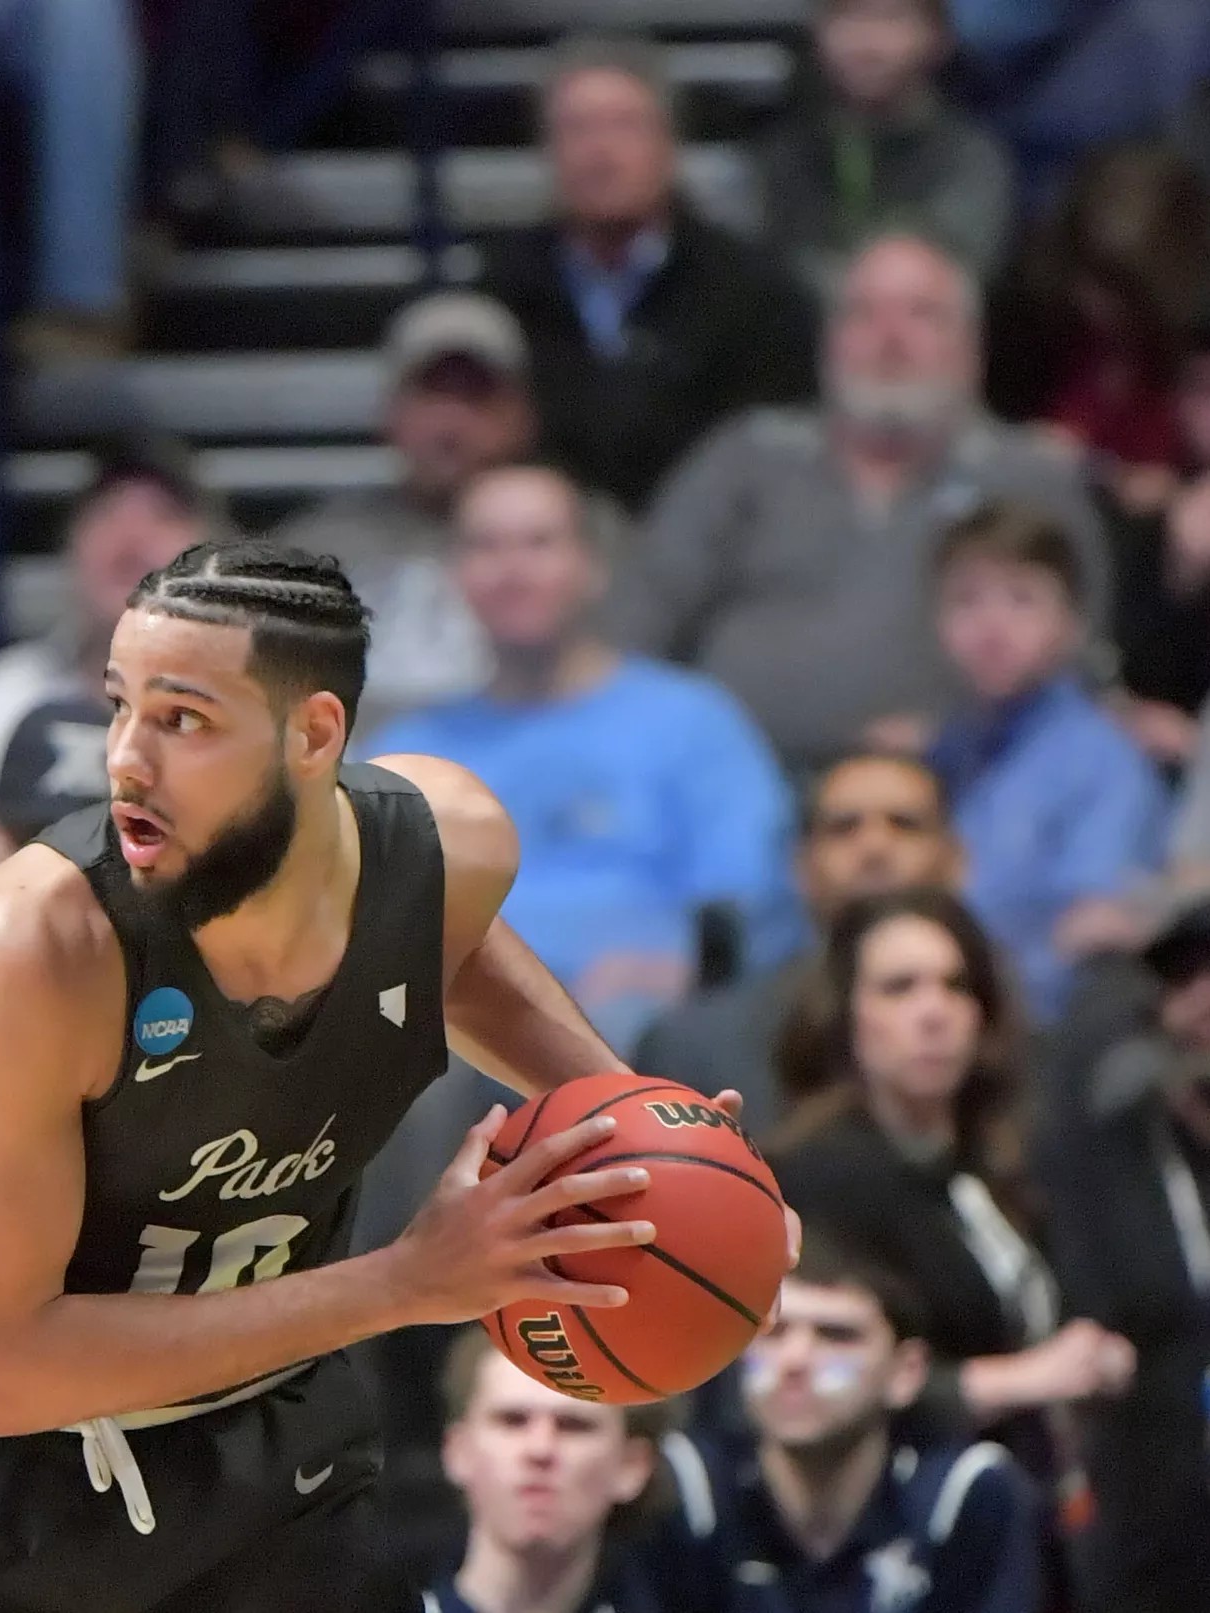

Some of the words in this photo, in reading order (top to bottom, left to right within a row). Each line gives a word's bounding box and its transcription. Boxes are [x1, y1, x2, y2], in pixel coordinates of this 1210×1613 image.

[142, 1018, 189, 1040] NCAA
[159, 1113, 337, 1201] Pack
[516, 1311, 605, 1402] Wil
